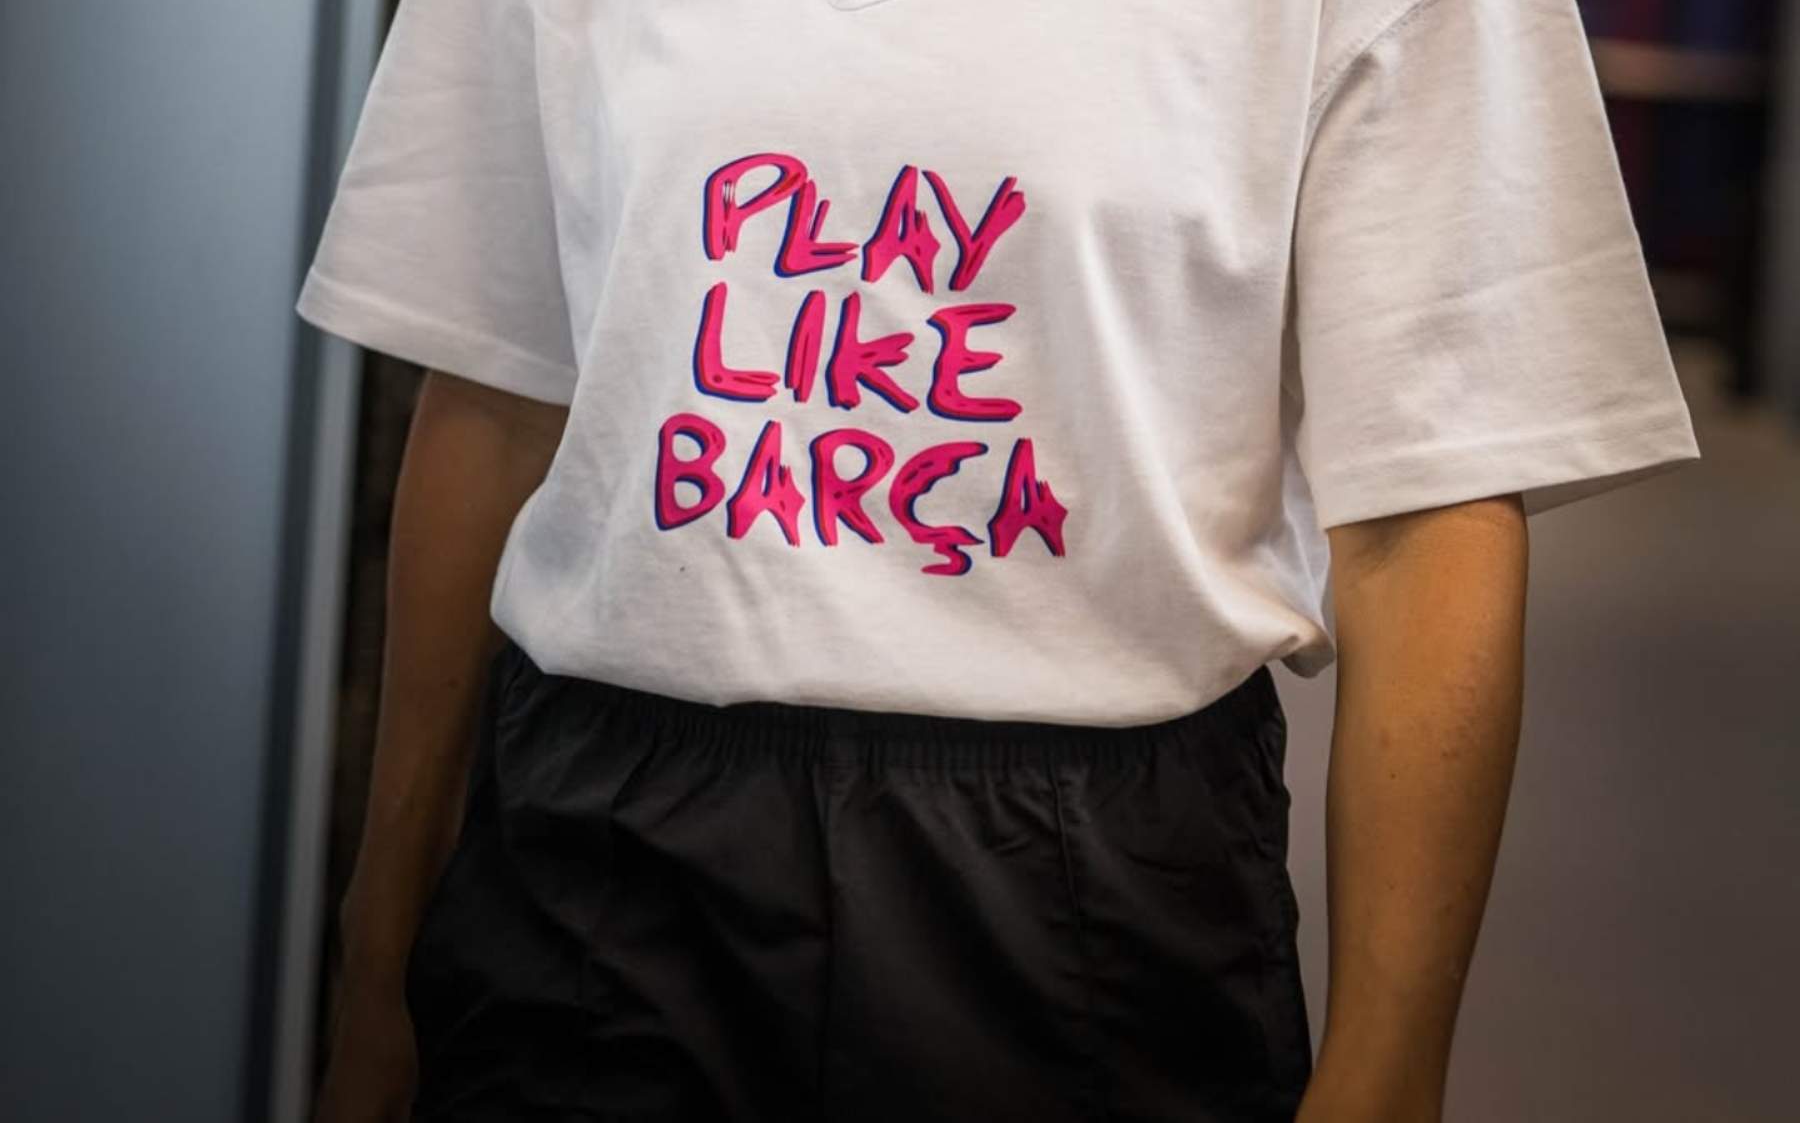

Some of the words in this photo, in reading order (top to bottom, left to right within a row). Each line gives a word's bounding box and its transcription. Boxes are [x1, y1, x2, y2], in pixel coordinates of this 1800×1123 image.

[702, 152, 1027, 295] PLAY
[692, 281, 1024, 422] LIKE
[654, 412, 1069, 576] BARÇA
